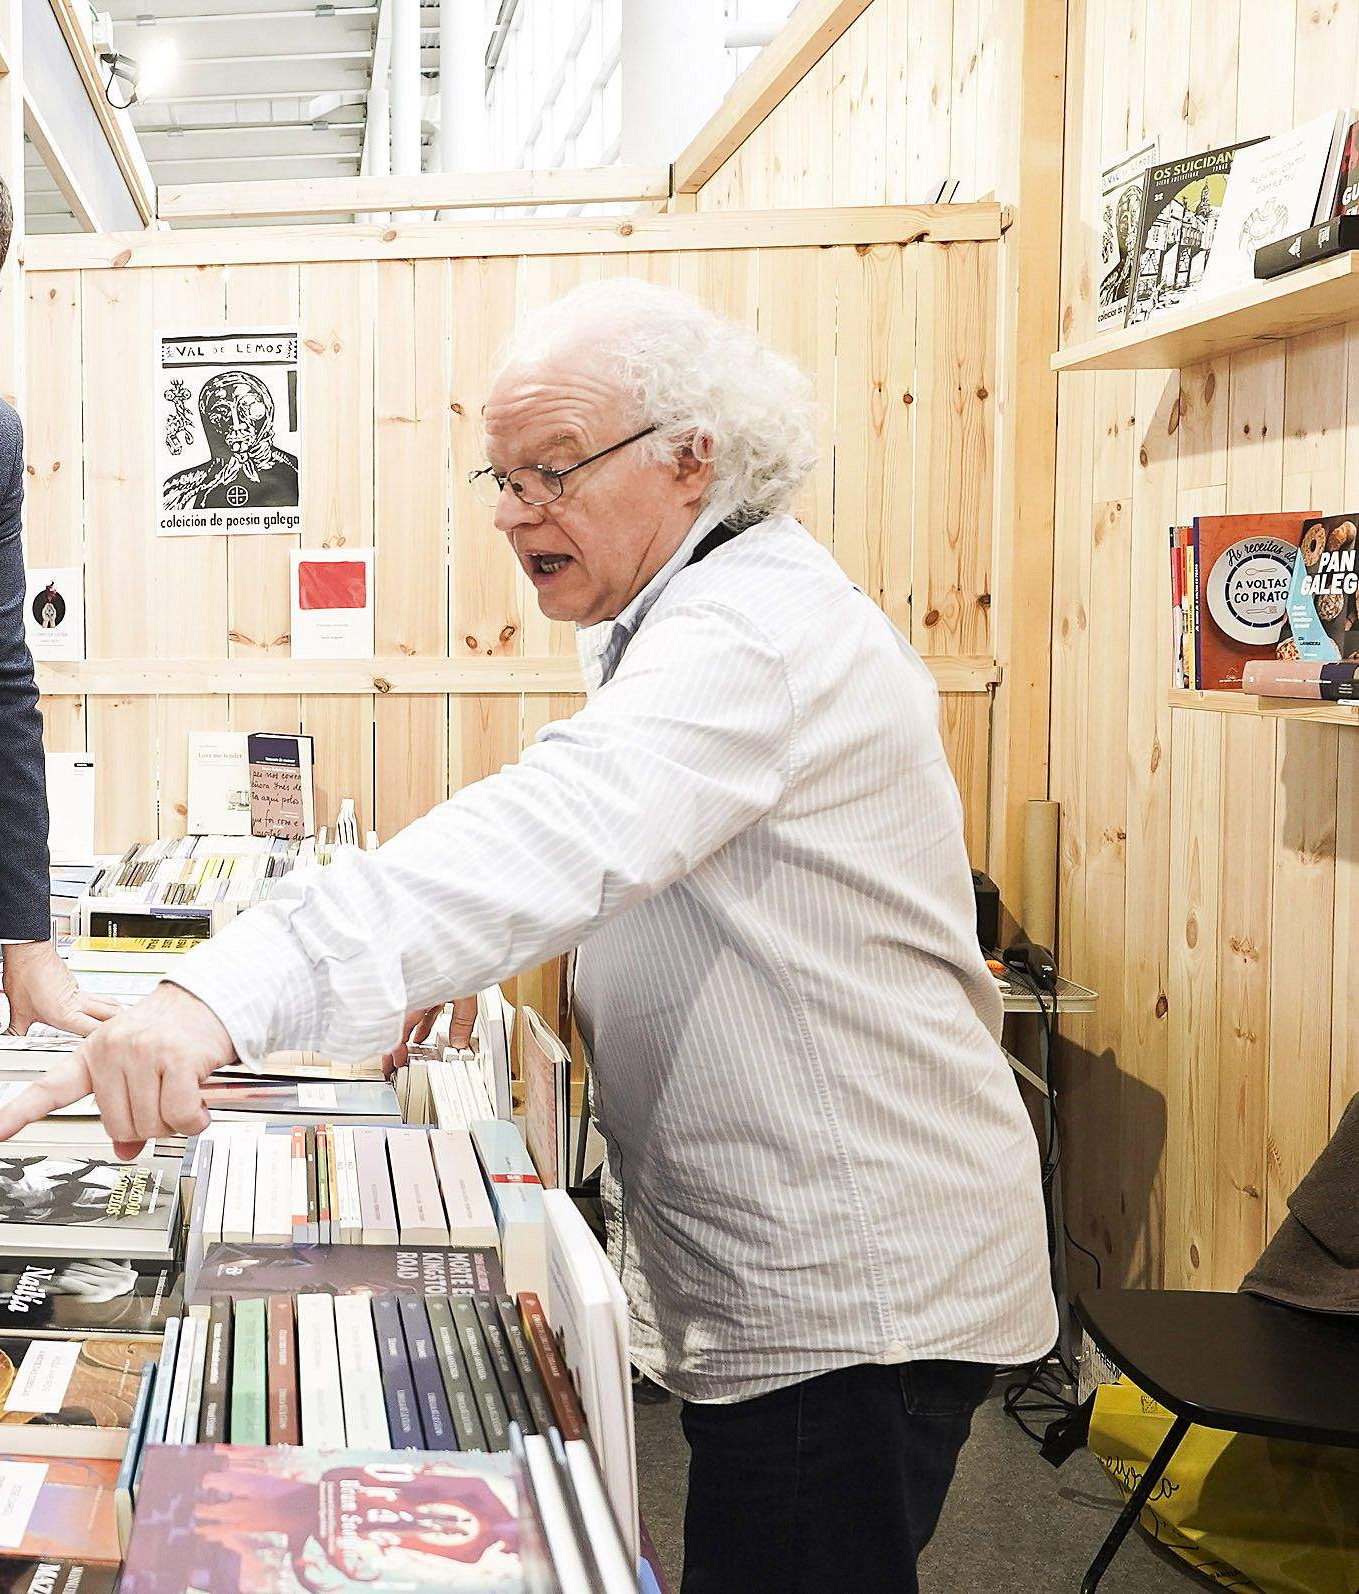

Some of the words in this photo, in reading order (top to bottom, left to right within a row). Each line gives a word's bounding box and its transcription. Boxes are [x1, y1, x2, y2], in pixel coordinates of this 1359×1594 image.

[1153, 167, 1172, 181] OS
[175, 346, 205, 357] VAL
[236, 343, 283, 354] LEMOS
[210, 513, 223, 526] de
[263, 511, 300, 530] galega
[1244, 540, 1283, 555] receitas
[1318, 549, 1357, 573] PAN
[1235, 580, 1243, 590] A
[1246, 577, 1288, 589] VOLTAS
[1300, 572, 1359, 596] GALEG
[1234, 592, 1250, 604] CO
[1252, 591, 1290, 603] PRATO
[124, 1174, 149, 1216] LANZADOR
[396, 1251, 420, 1280] ROAD
[448, 1252, 474, 1286] MORTE
